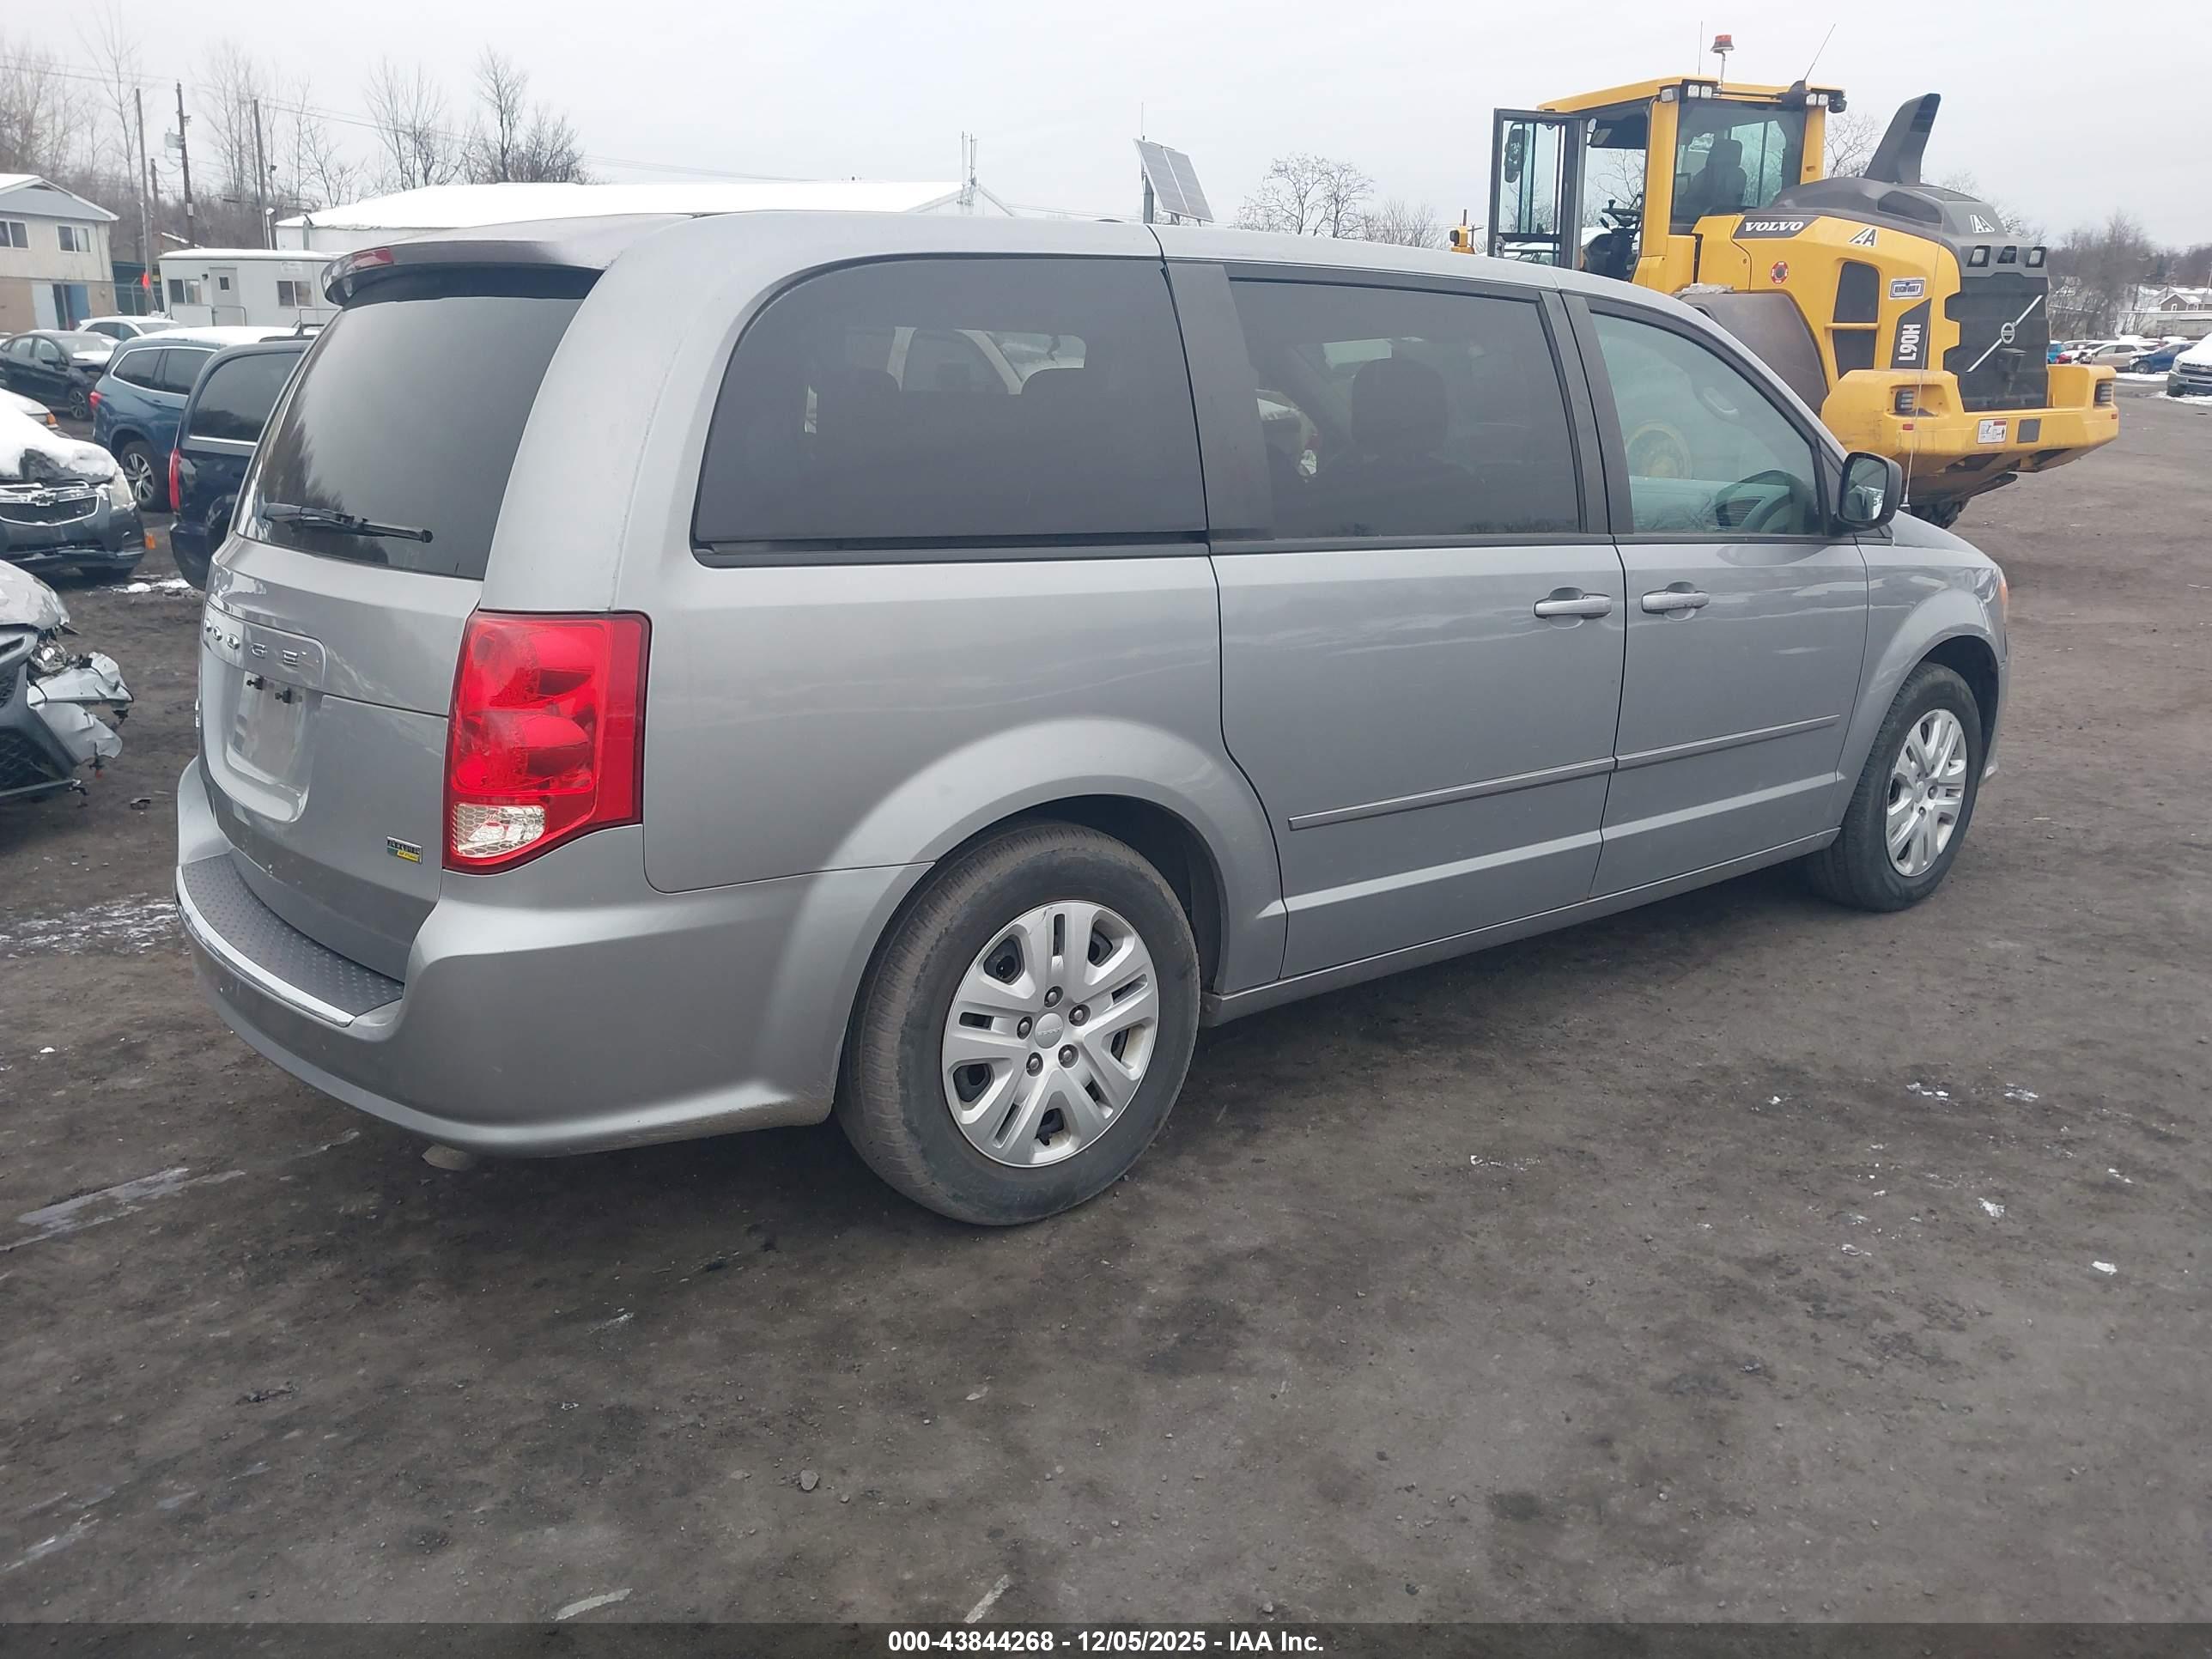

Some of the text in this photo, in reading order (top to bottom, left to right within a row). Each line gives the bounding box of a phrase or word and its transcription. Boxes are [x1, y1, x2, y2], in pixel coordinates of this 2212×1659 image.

[1745, 221, 1804, 232] VOLVO
[1898, 324, 1922, 361] L90H
[205, 617, 299, 667] DODGE
